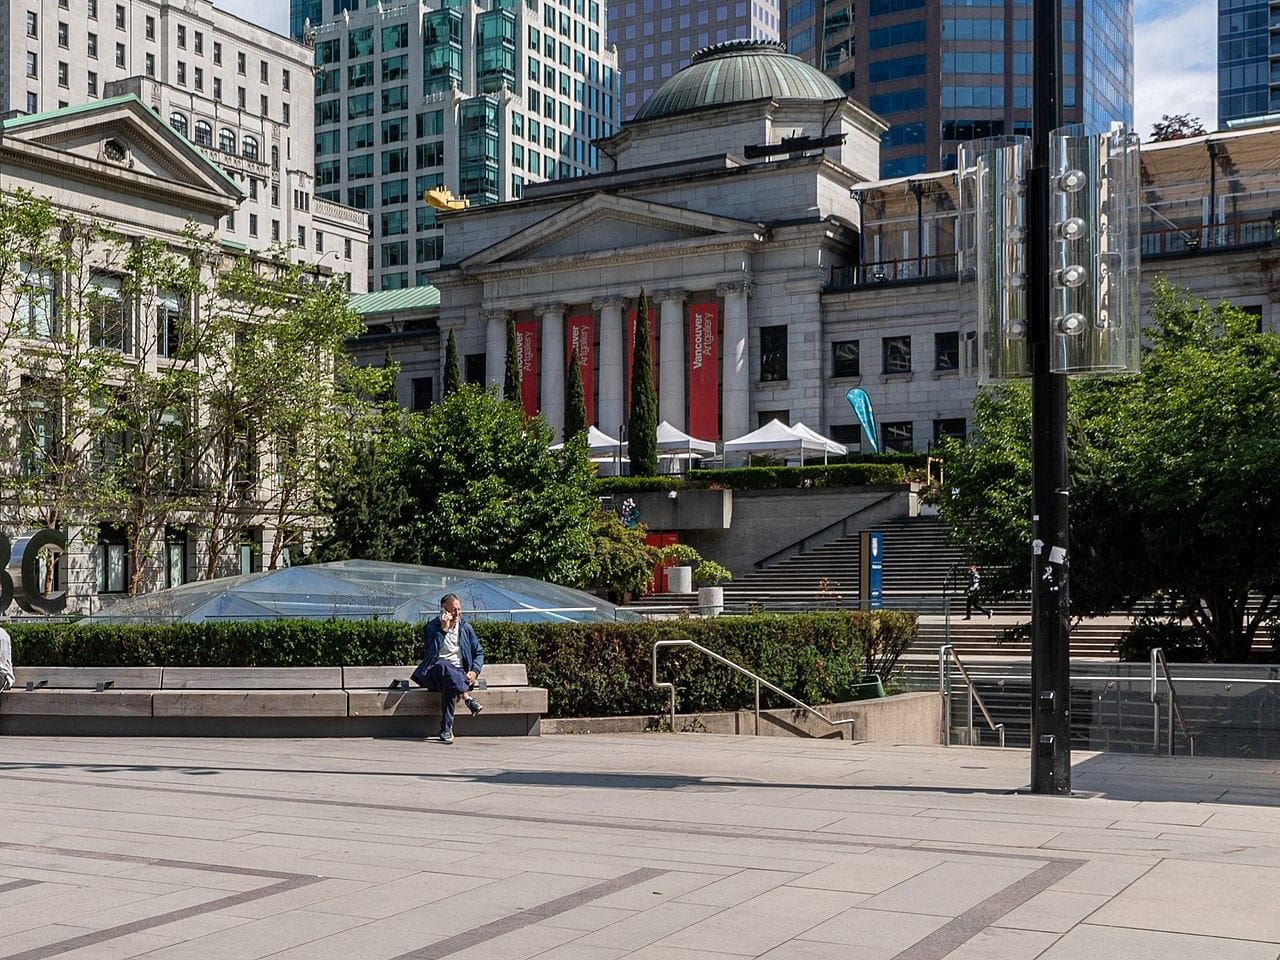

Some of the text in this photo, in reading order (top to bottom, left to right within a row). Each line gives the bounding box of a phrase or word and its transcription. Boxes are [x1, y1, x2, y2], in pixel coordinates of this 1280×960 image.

[523, 331, 533, 372] Artgallery
[580, 325, 590, 367] Artgallery
[693, 313, 703, 370] Vancouver
[703, 312, 714, 356] Artgallery
